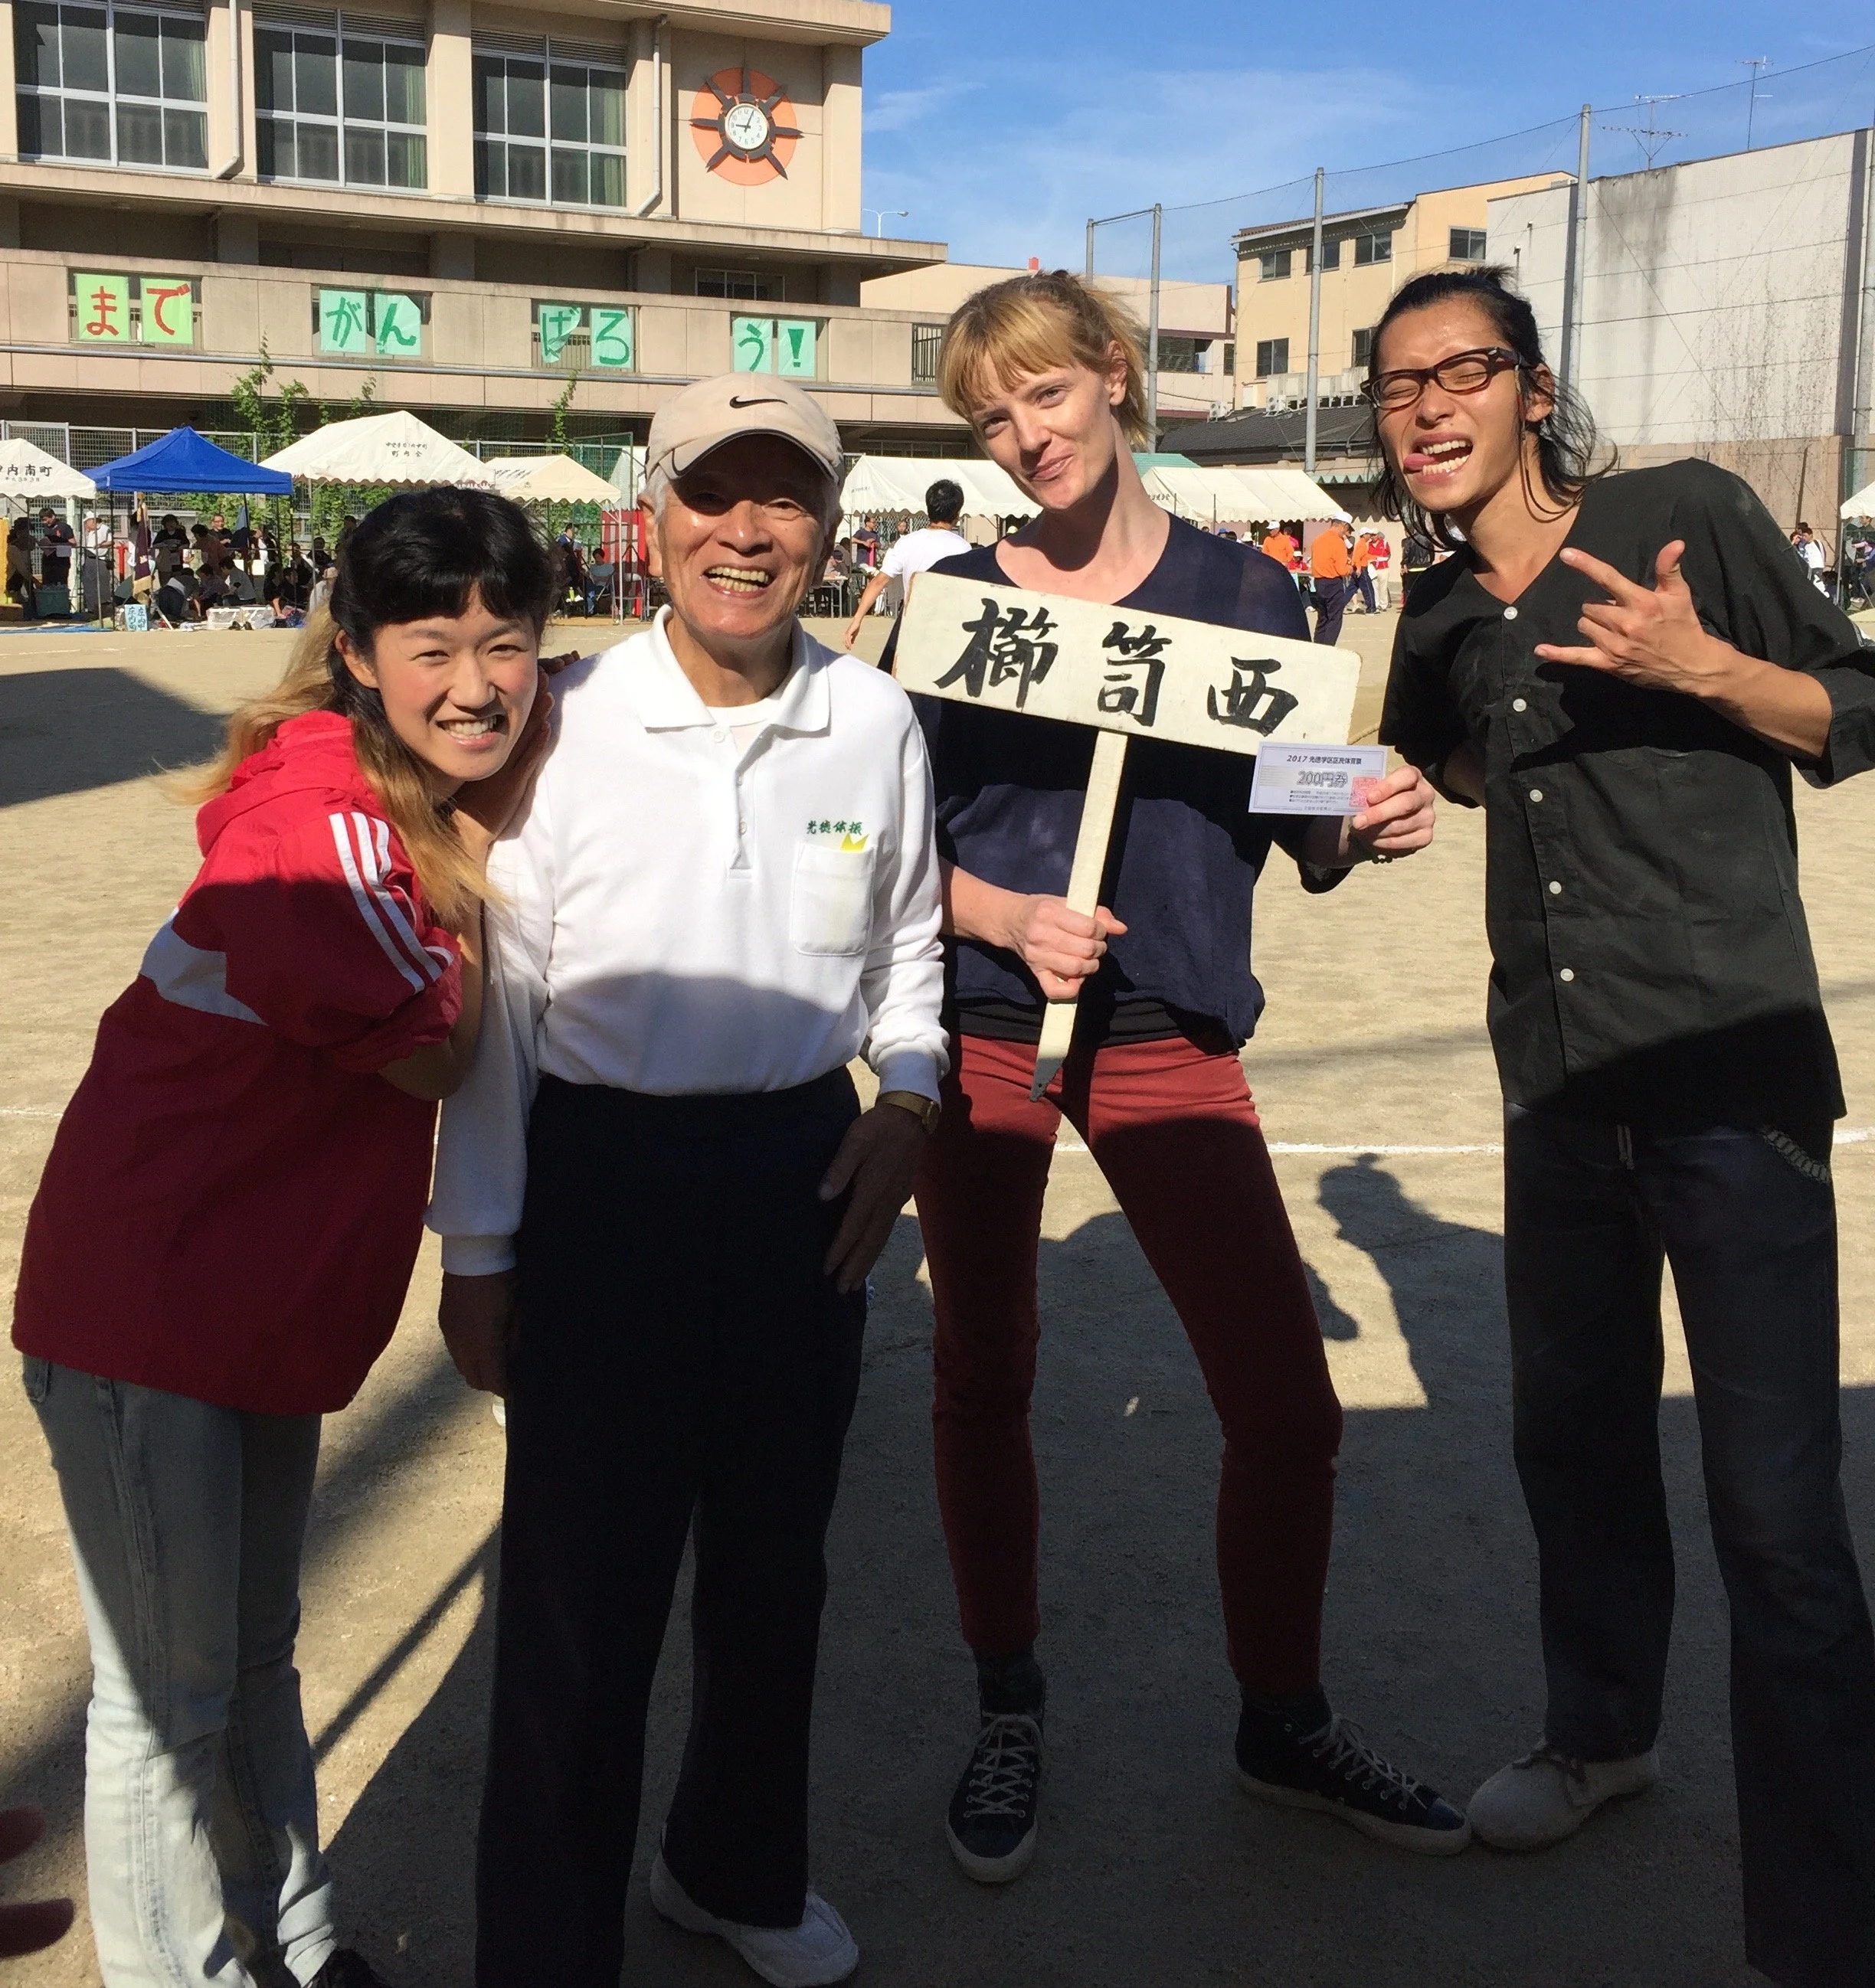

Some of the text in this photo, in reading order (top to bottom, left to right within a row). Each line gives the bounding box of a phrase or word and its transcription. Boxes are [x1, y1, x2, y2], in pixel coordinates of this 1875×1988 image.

[86, 283, 191, 337] まで
[325, 296, 417, 348] がん
[1287, 754, 1307, 763] 2017
[1296, 770, 1349, 788] 200円券
